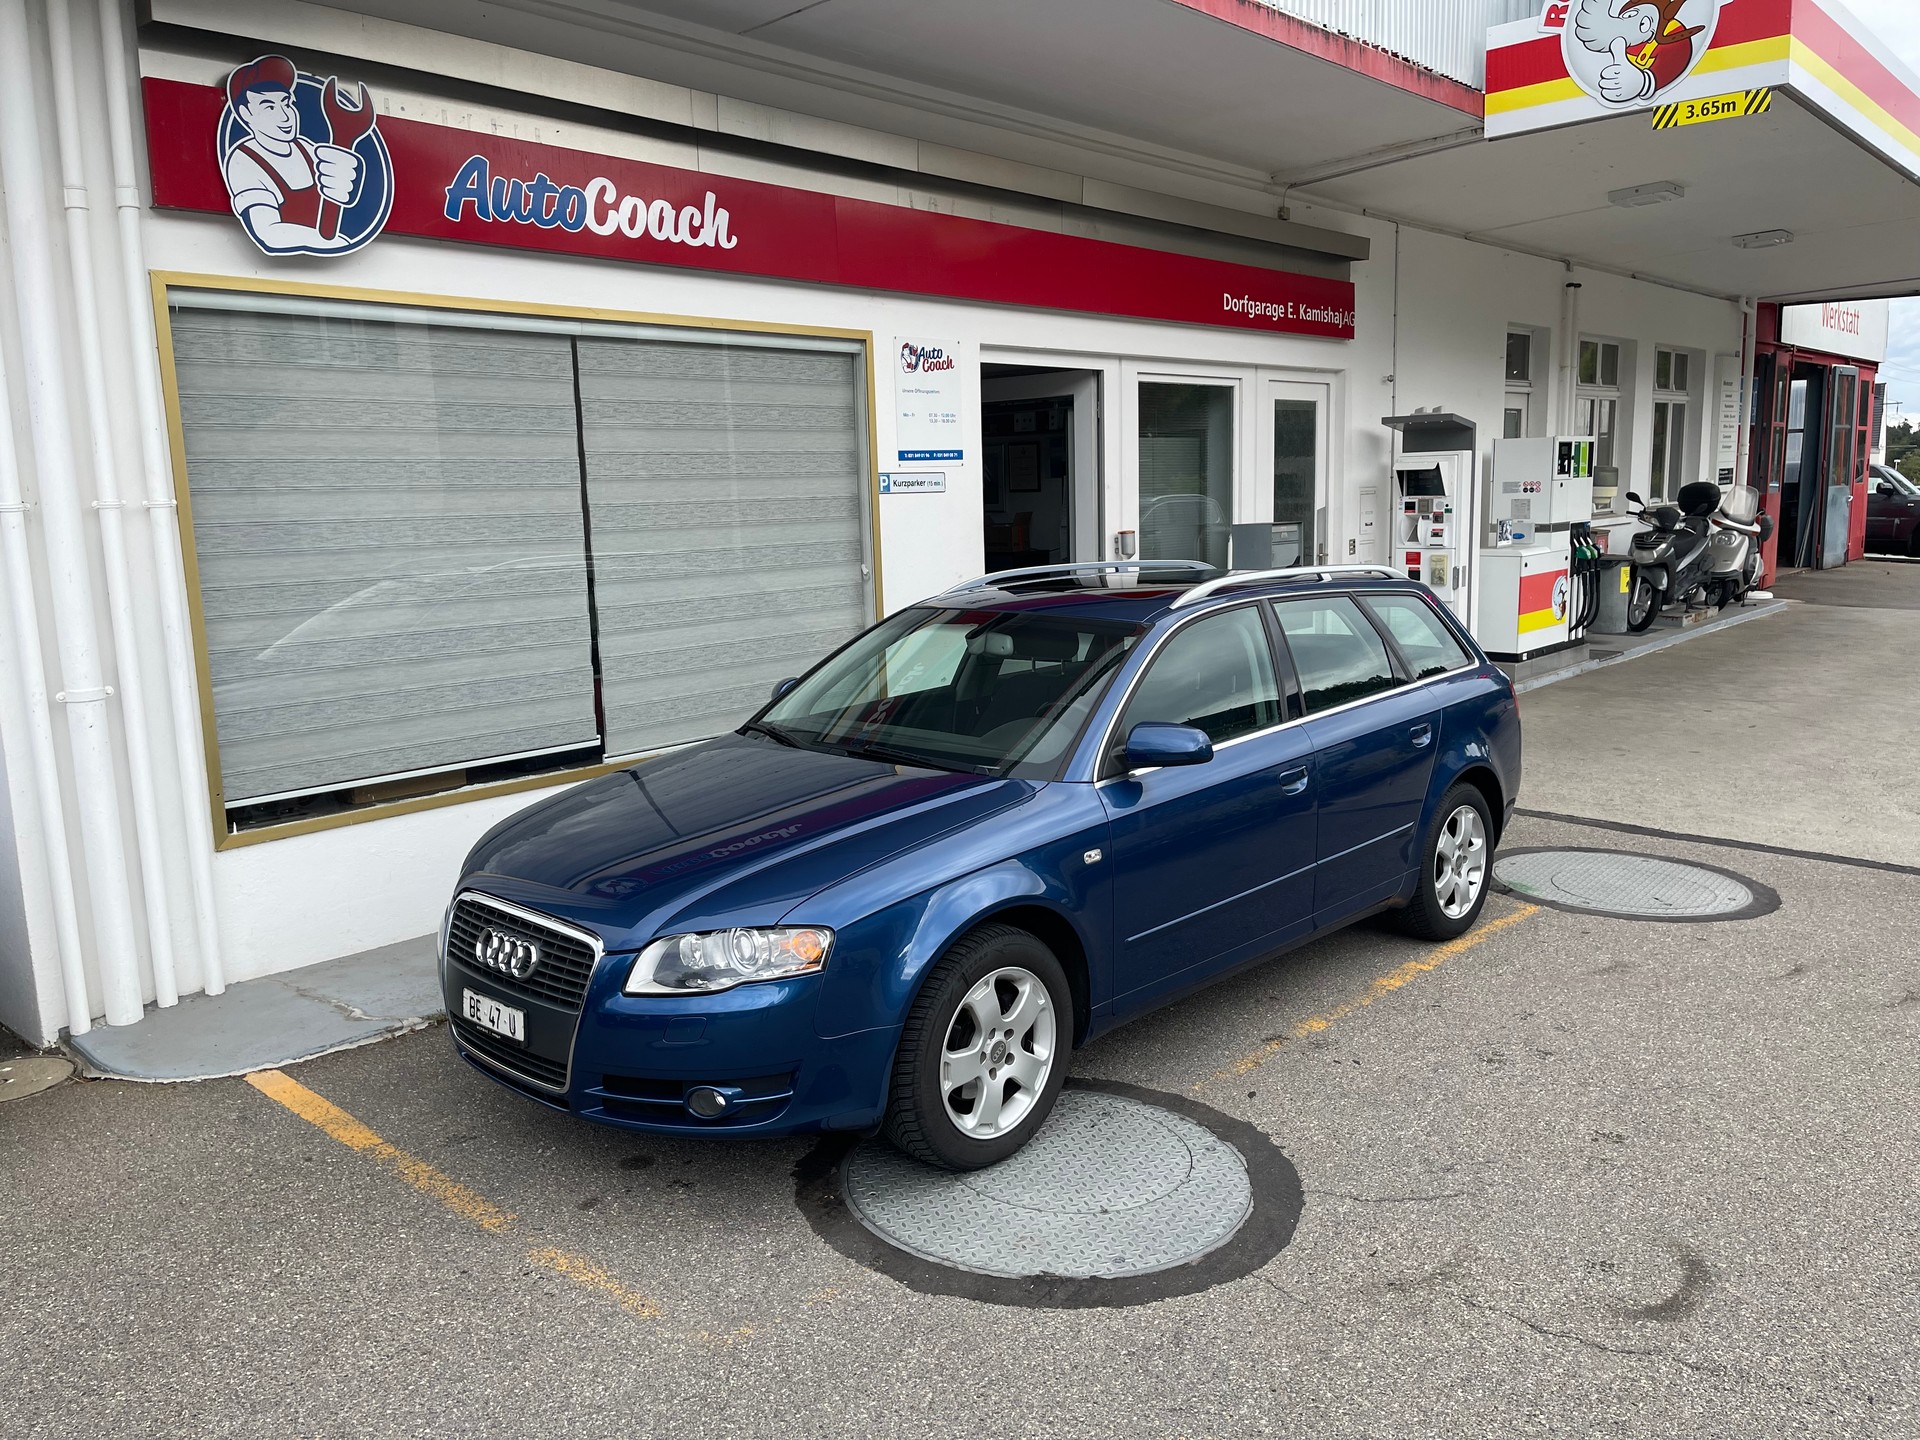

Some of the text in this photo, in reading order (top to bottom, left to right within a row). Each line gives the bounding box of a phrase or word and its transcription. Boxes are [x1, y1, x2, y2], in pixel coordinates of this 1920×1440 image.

[1686, 100, 1737, 119] 3.65m
[444, 154, 738, 249] AutoCoach
[1223, 292, 1285, 321] Dorfgarage
[1287, 302, 1297, 319] E.
[1299, 303, 1343, 328] Kamishaj
[1821, 302, 1860, 336] Werkstatt
[918, 346, 943, 362] Auto
[922, 355, 955, 373] Coach
[892, 479, 926, 489] Kurzparker
[469, 996, 482, 1021] BE
[488, 1004, 501, 1030] 47
